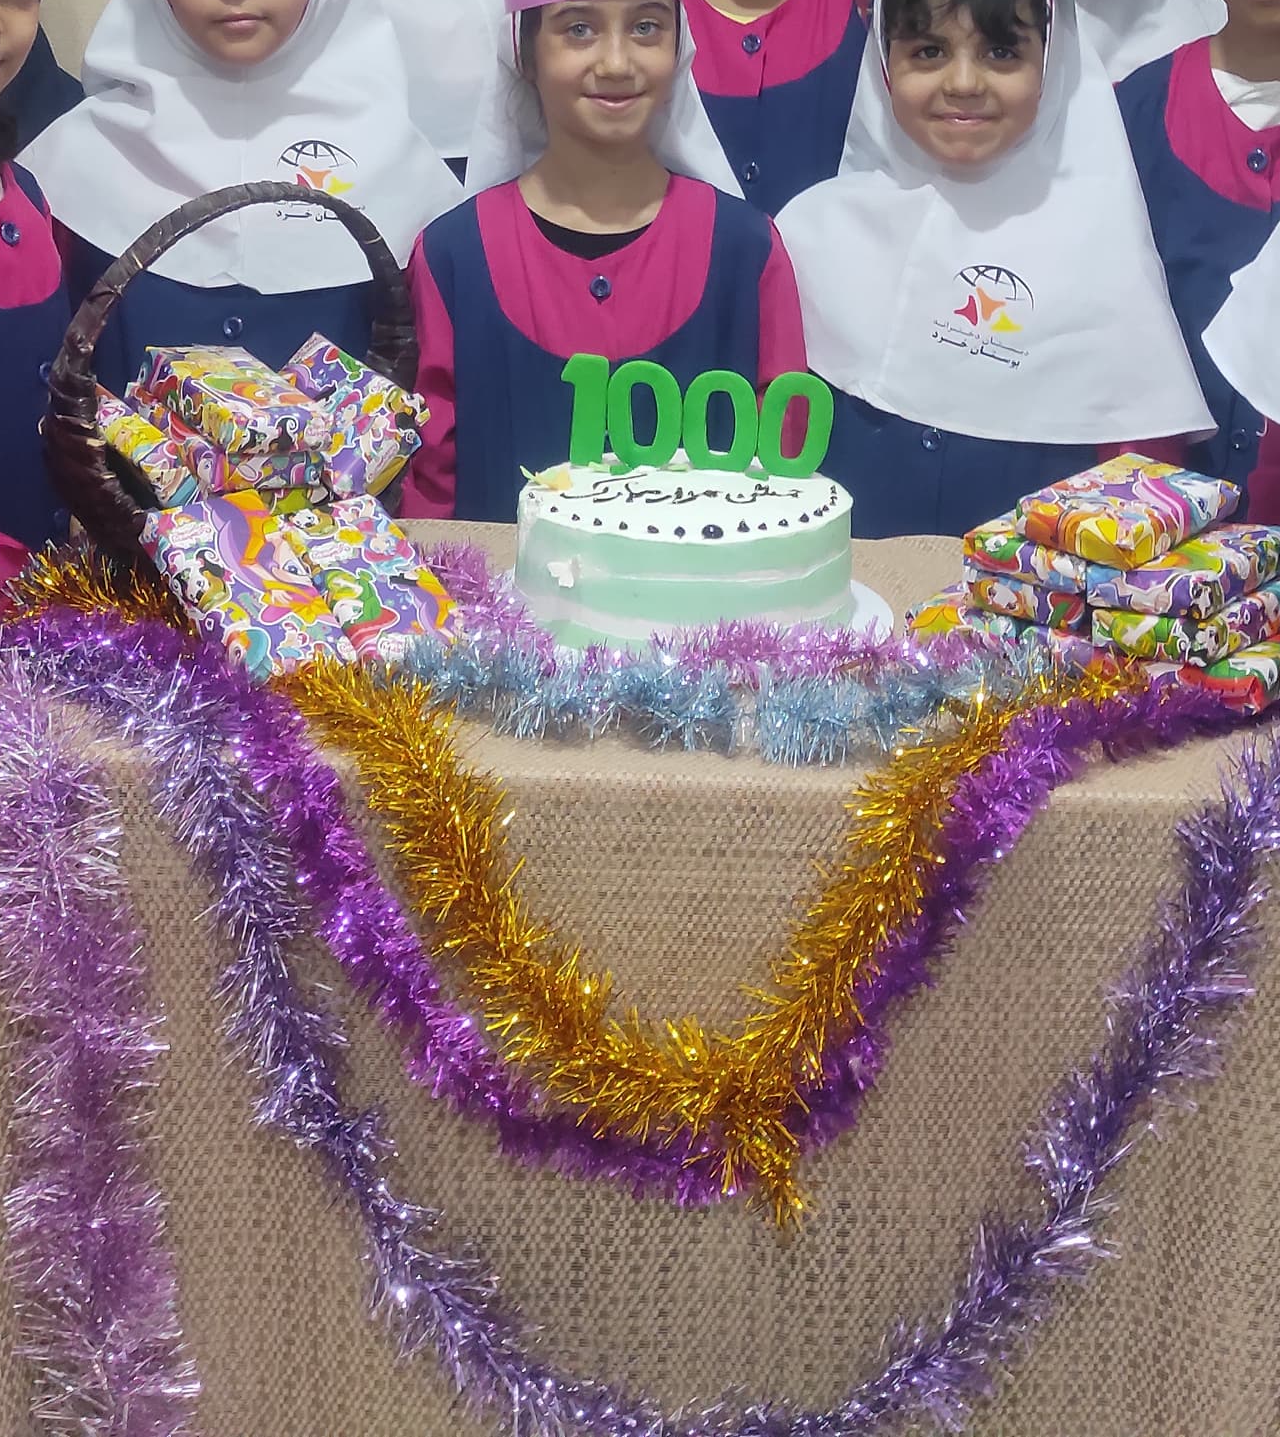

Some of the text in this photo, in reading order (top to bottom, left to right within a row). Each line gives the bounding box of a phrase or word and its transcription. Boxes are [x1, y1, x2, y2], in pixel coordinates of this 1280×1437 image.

[931, 330, 1021, 370] بوستان خرد
[561, 353, 834, 478] 1000
